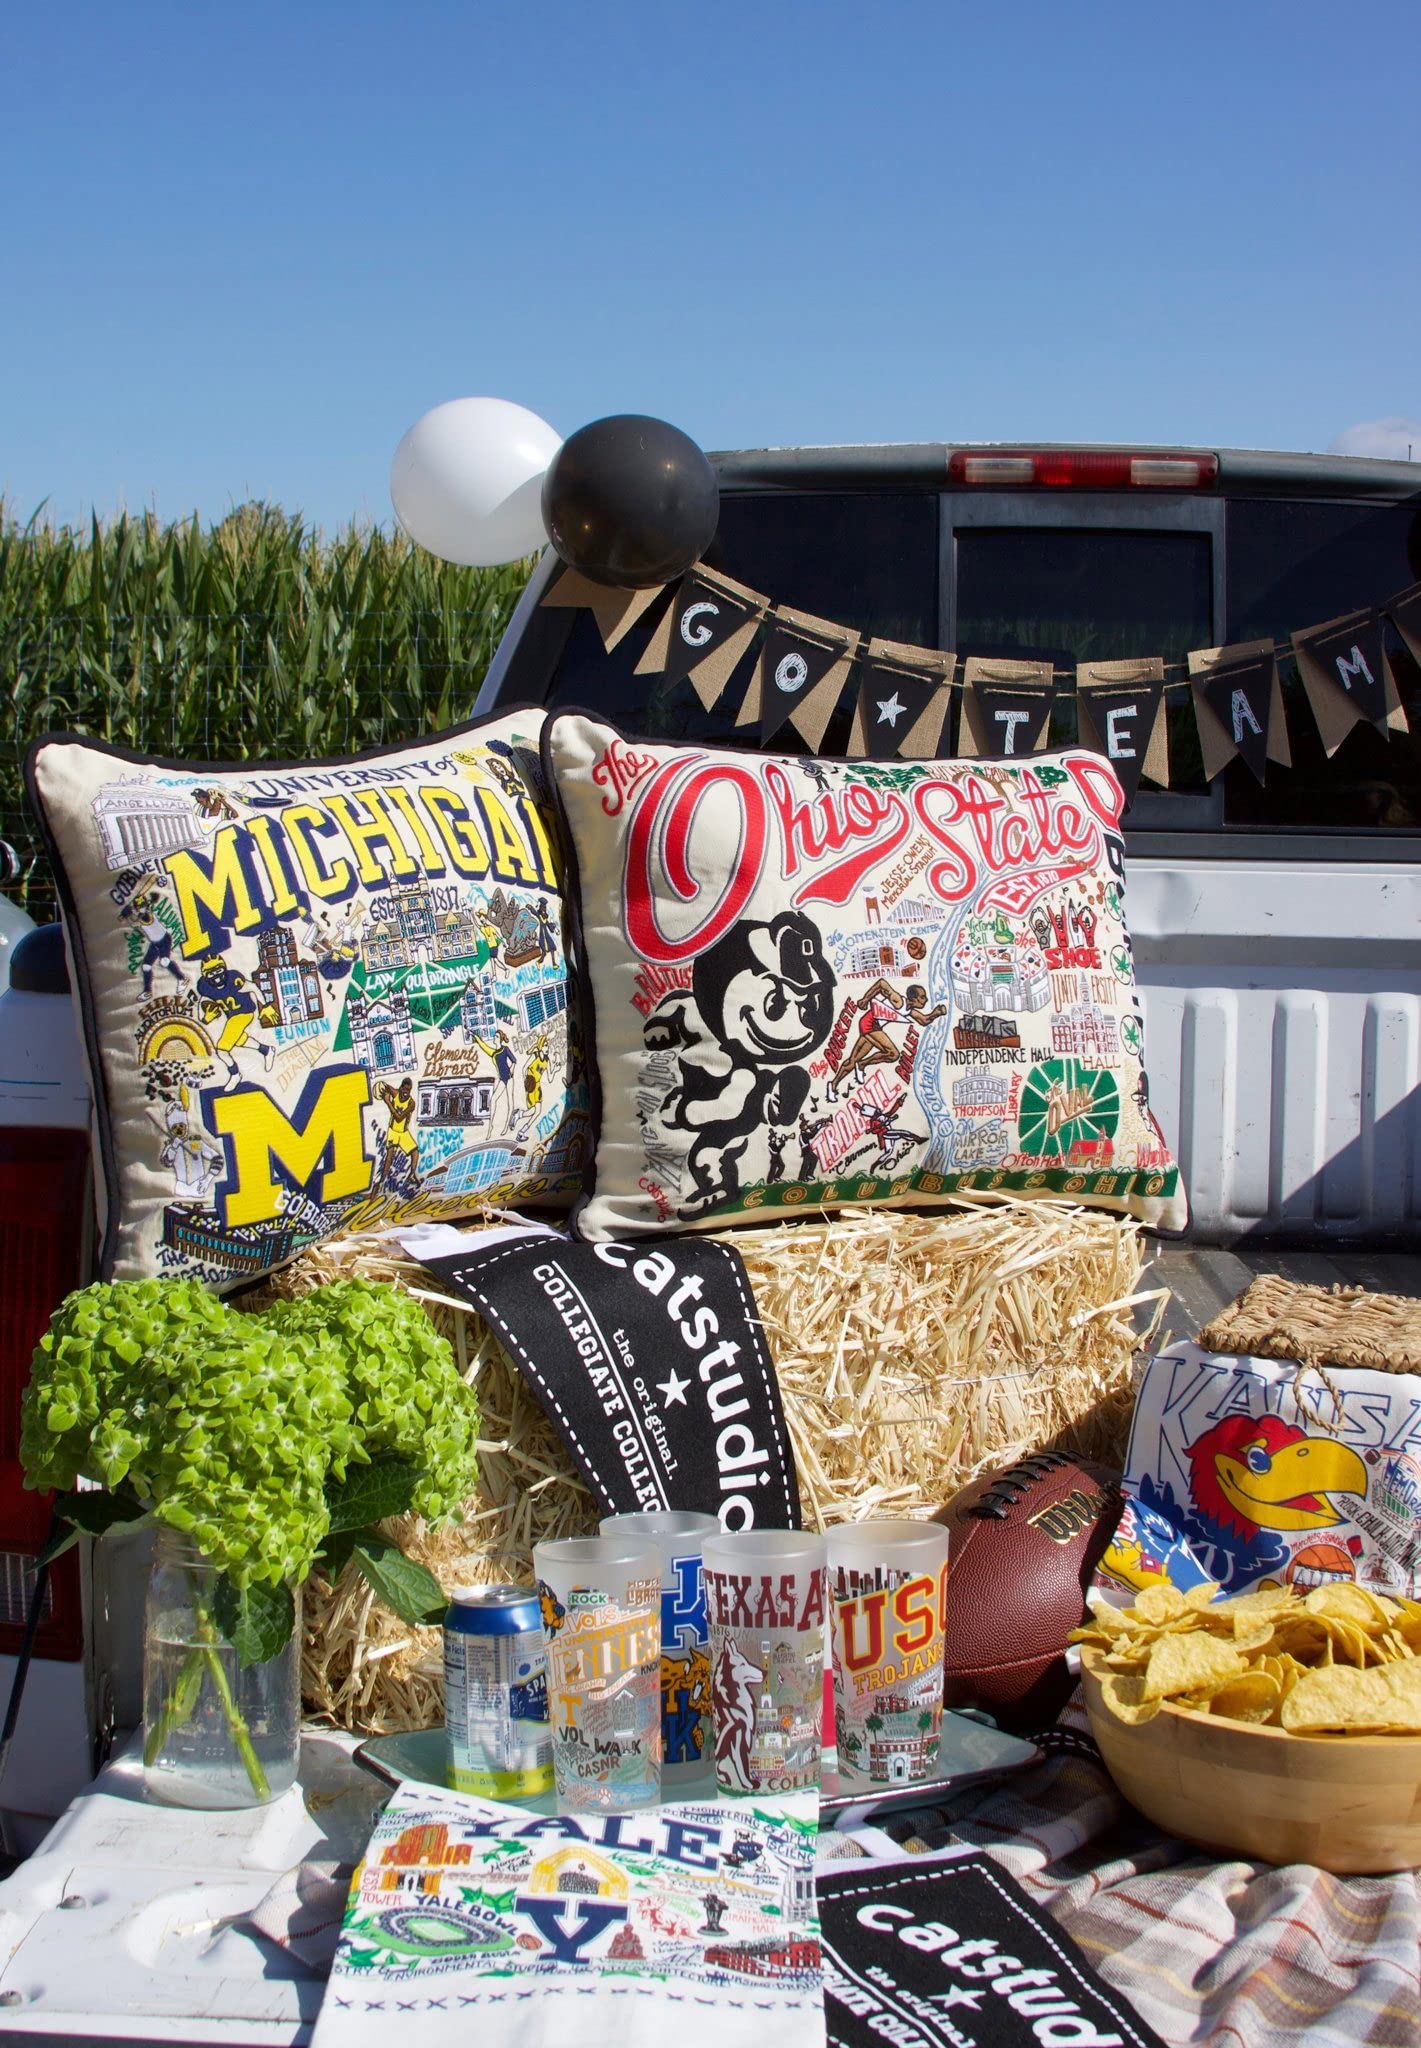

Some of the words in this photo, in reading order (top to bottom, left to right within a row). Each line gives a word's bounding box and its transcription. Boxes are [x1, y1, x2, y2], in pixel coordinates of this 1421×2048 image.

[248, 760, 439, 797] UNIVERSITY
[434, 755, 460, 777] of
[592, 740, 659, 816] The
[623, 754, 911, 966] Ohio
[910, 766, 1102, 918] State
[1035, 869, 1061, 889] 1870
[1043, 947, 1103, 970] SHOE
[364, 972, 397, 992] LAW
[405, 963, 480, 991] QUADRANGLE
[284, 1019, 331, 1039] UNION
[945, 1047, 1027, 1067] INDEPENDENCE
[1030, 1046, 1055, 1063] HALL
[1081, 1056, 1121, 1071] HALL
[1003, 1070, 1023, 1124] LIBRARY
[952, 1104, 1008, 1118] THOMPSON
[954, 1148, 985, 1161] LAKE
[1001, 1152, 1039, 1170] Orton
[1063, 1174, 1165, 1196] OHIO
[532, 1264, 625, 1417] COLLEGIATE
[612, 1327, 635, 1370] the
[571, 1593, 608, 1605] ROCK
[558, 1693, 582, 1727] T
[558, 1726, 590, 1748] VOL
[362, 1892, 402, 1906] TOWER
[414, 1894, 464, 1913] YALE
[468, 1902, 519, 1937] BOWL
[513, 1894, 630, 1965] Y
